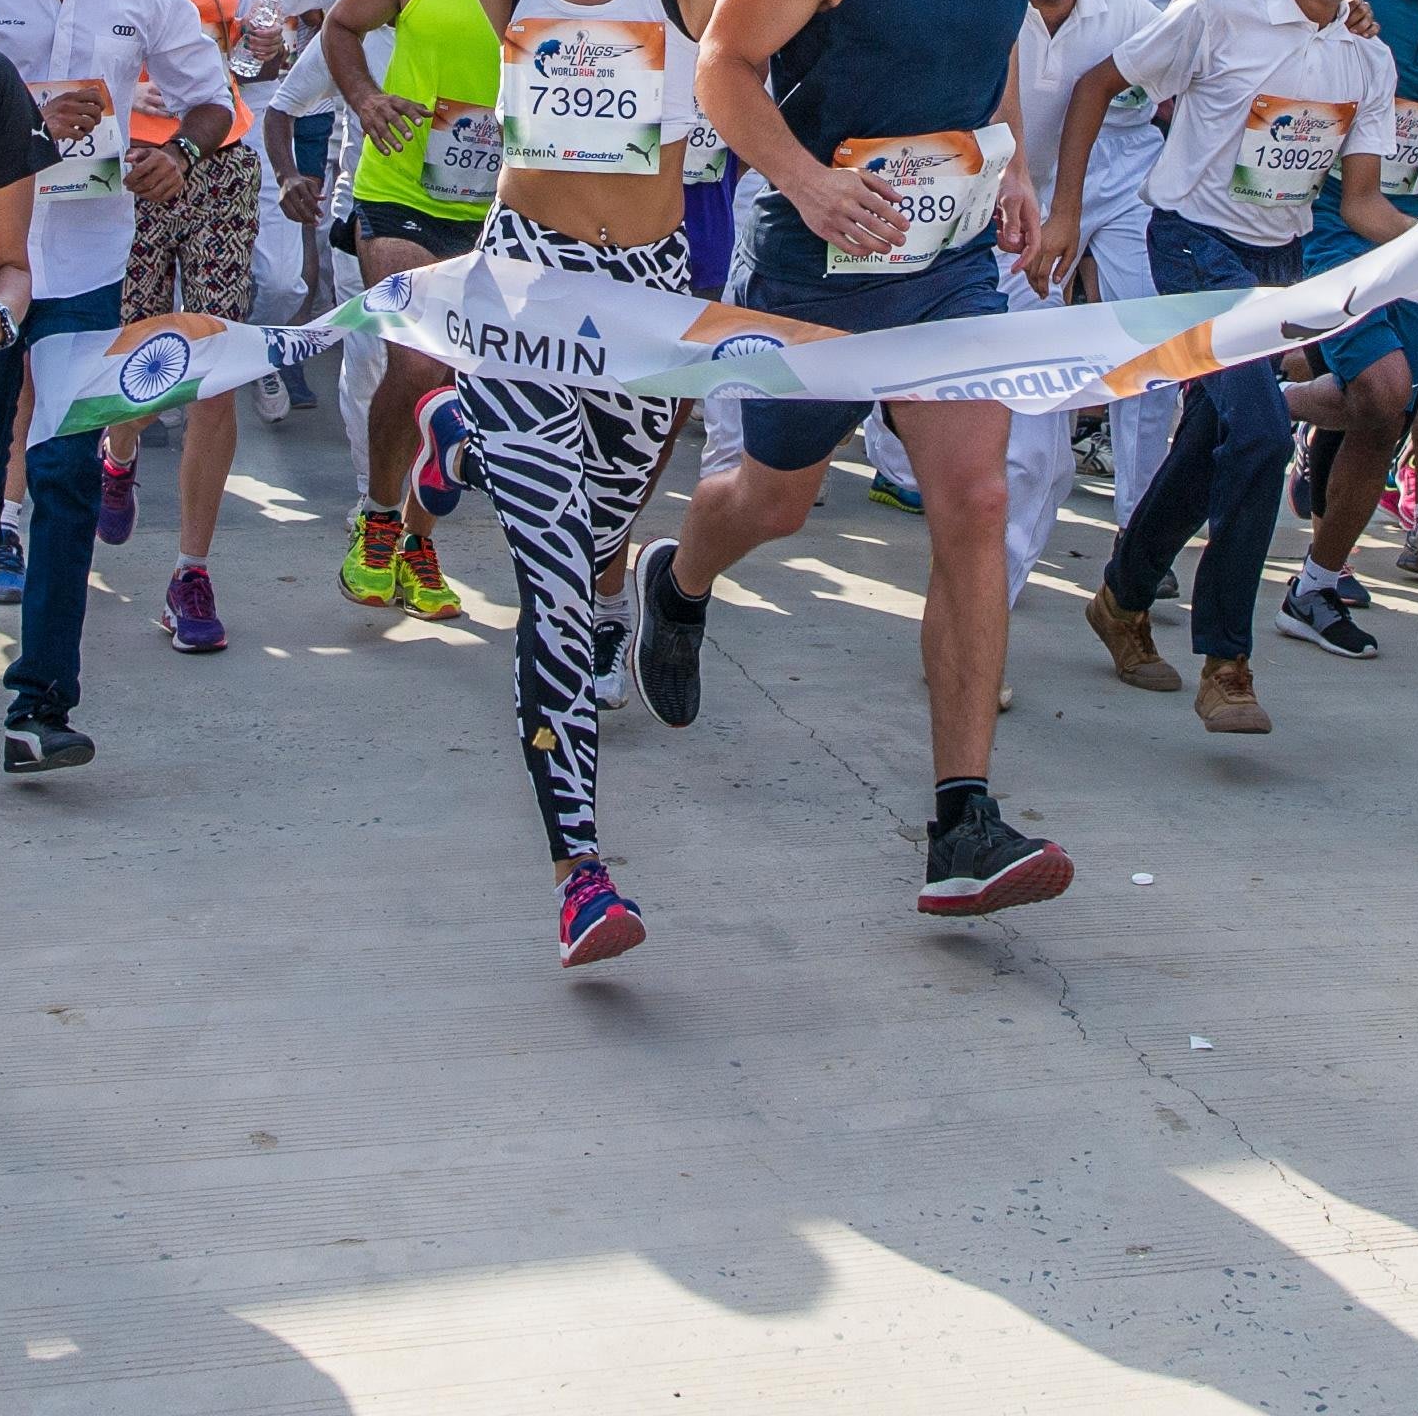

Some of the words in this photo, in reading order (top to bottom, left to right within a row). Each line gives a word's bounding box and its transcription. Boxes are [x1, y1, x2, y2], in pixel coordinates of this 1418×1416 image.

[564, 43, 614, 57] WINGS
[569, 56, 599, 67] LIFE
[596, 68, 615, 78] 2016
[529, 86, 637, 119] 73926
[61, 134, 96, 158] 23
[506, 146, 556, 159] GARMIN
[562, 150, 624, 161] BFGoodrich
[443, 146, 501, 172] 5878
[1255, 146, 1334, 171] 139922
[1233, 186, 1273, 199] GARMIN
[891, 195, 956, 224] 889
[834, 254, 883, 263] GARMIN
[446, 310, 606, 377] GARMIN
